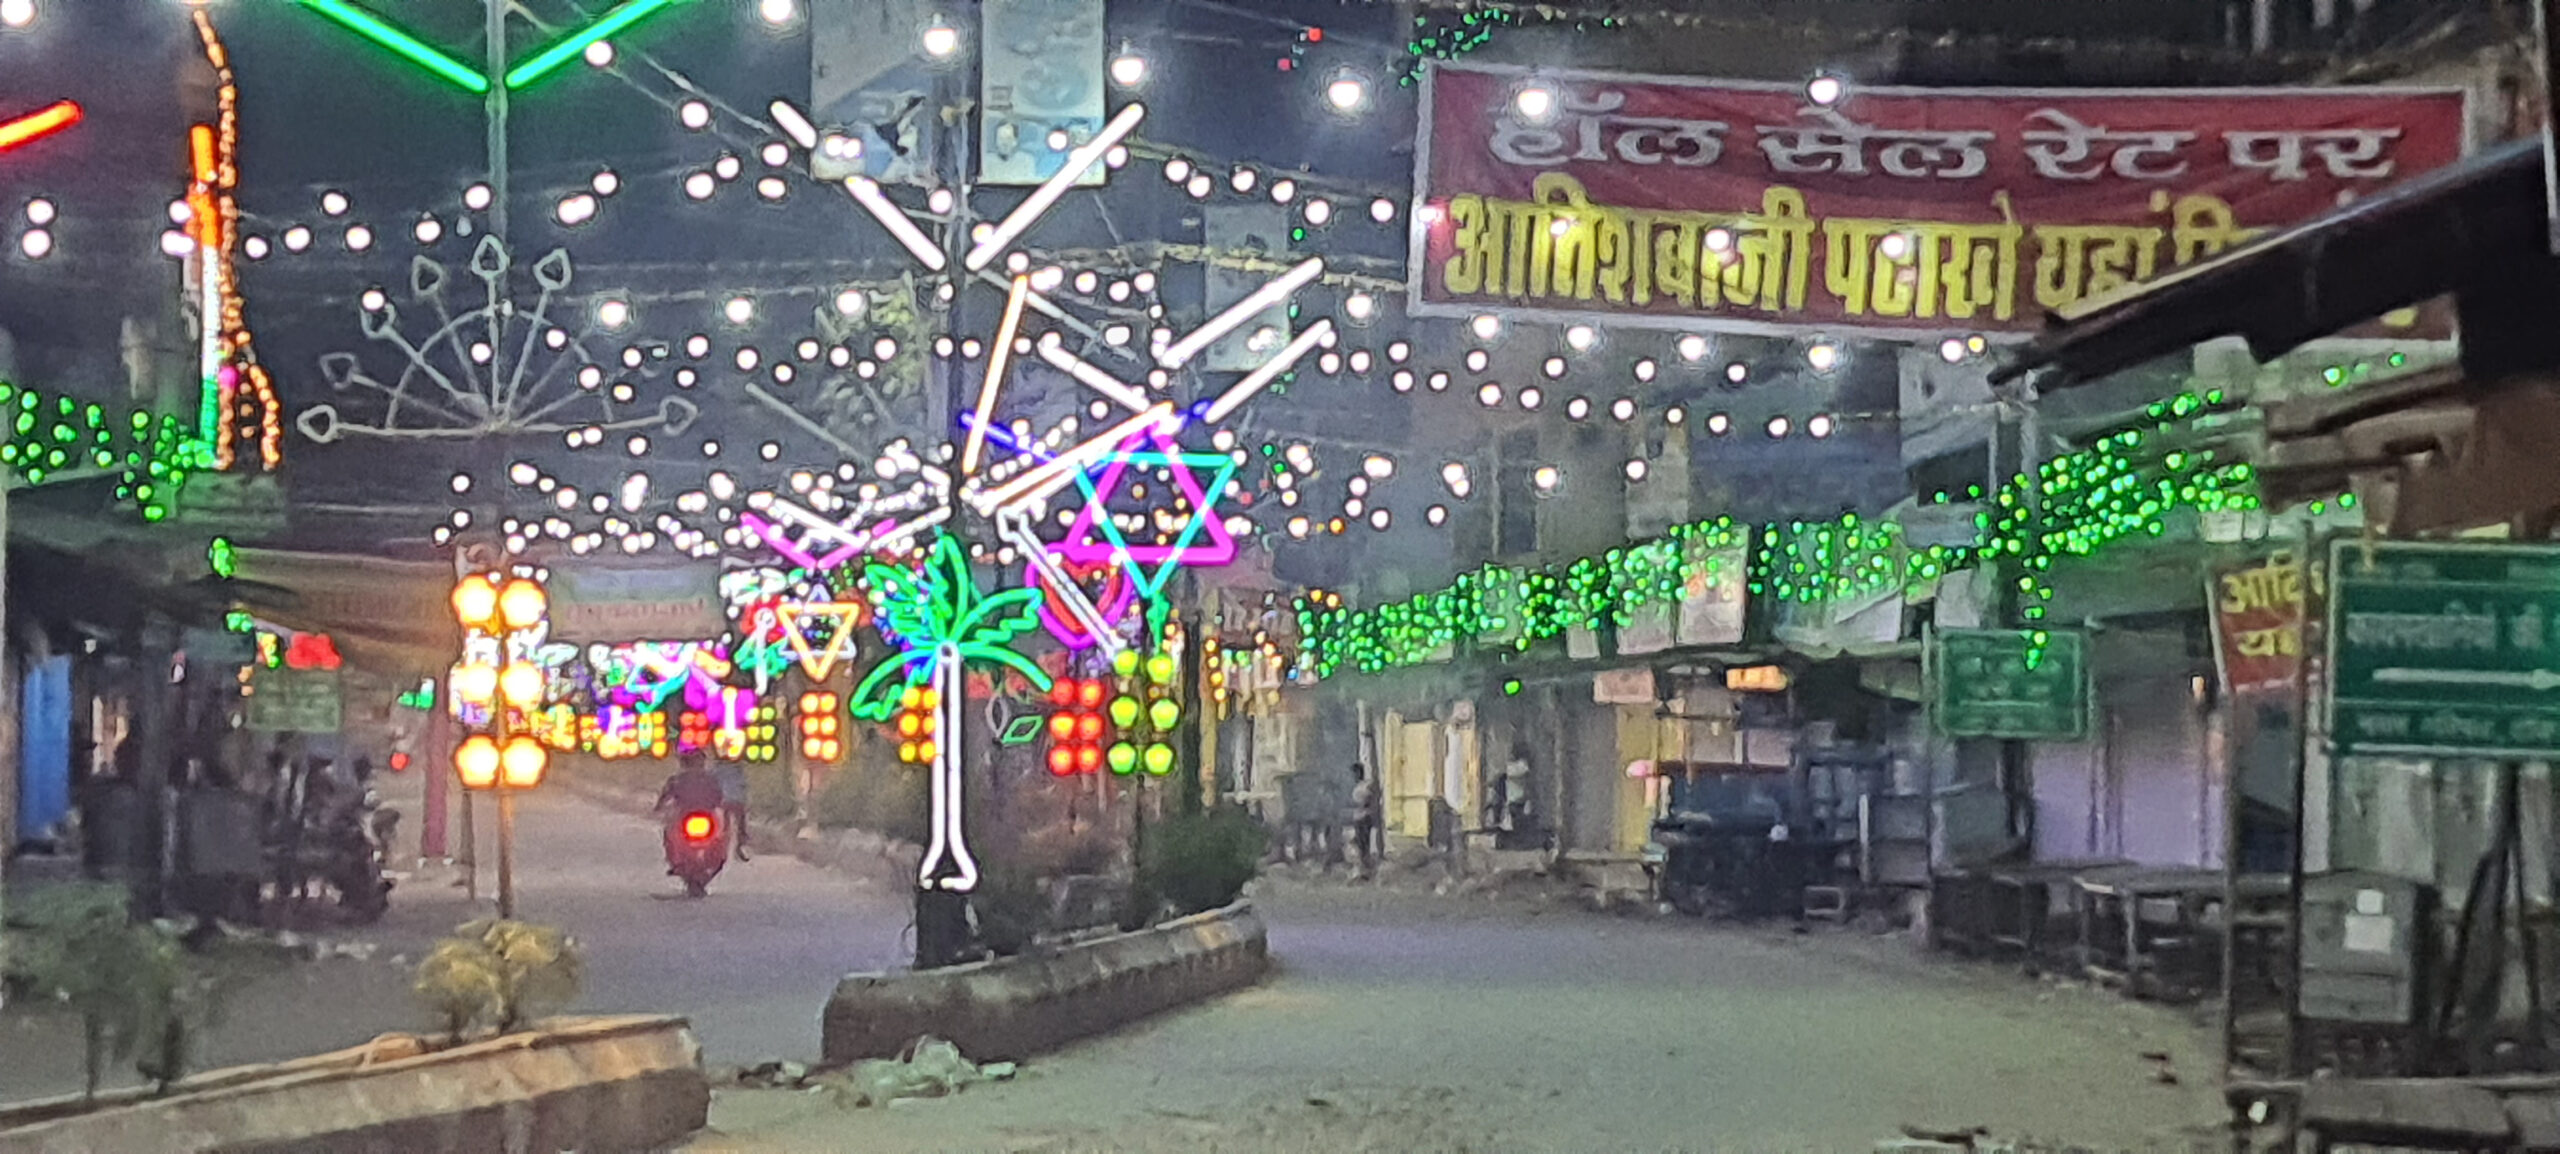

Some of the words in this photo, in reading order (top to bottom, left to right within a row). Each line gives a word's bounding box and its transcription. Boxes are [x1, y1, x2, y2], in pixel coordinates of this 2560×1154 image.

[1489, 90, 1730, 166] हॉल
[1755, 105, 1995, 178] सेल
[2022, 108, 2195, 179] रेट
[2222, 128, 2401, 180] पर
[1444, 171, 1815, 311] आतिशबाजी
[1822, 189, 2023, 321] पटाखे
